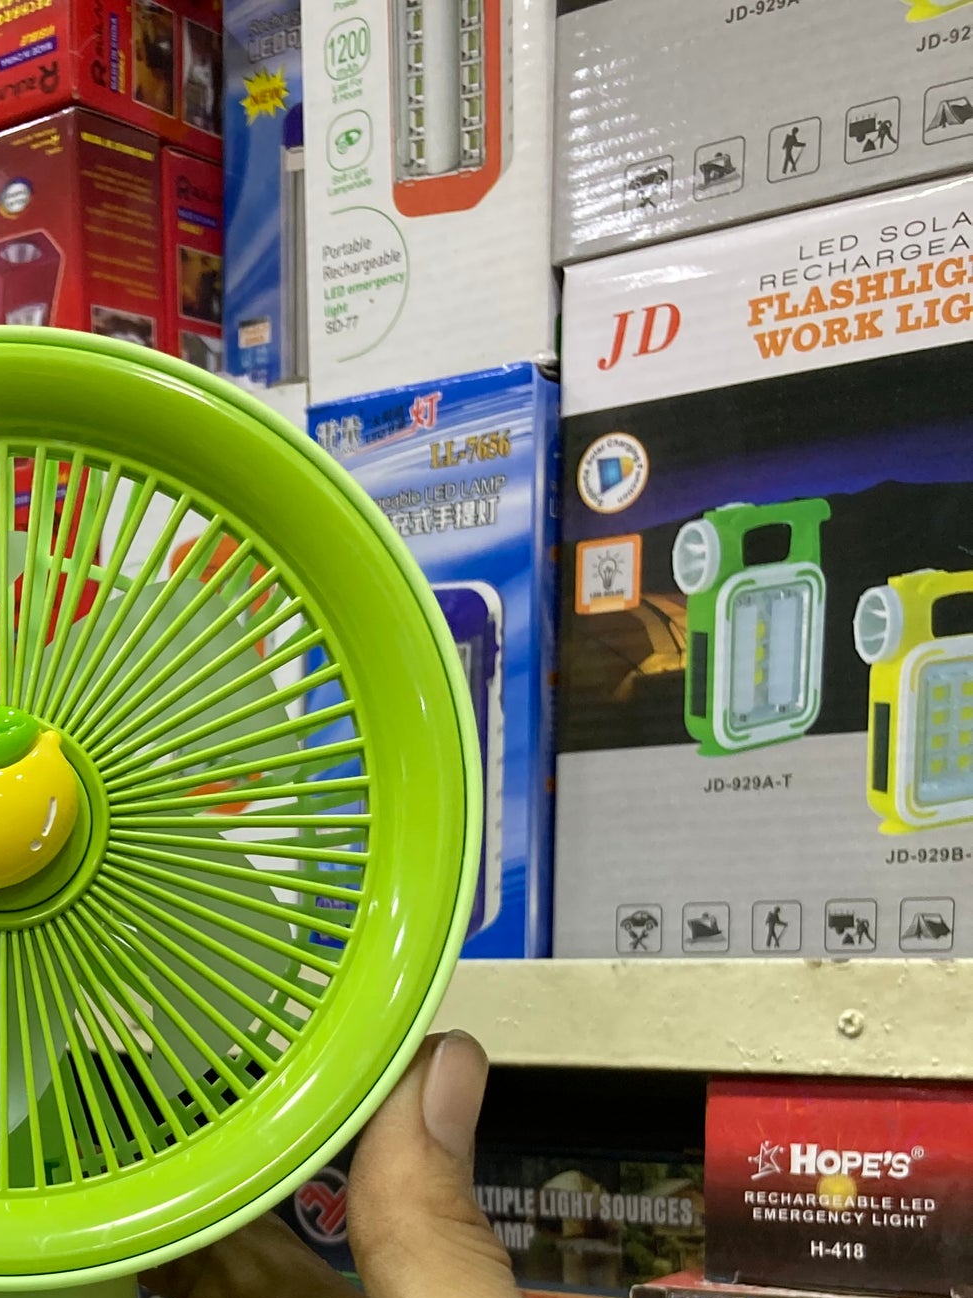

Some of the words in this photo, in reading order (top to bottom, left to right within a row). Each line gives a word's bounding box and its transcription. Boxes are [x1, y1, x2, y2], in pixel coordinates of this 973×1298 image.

[328, 26, 368, 68] 1200
[915, 24, 973, 53] JD-92
[322, 235, 373, 263] Portable
[798, 233, 860, 261] LED
[879, 211, 973, 243] SOLA
[322, 249, 403, 281] Rechargeable
[758, 235, 973, 292] RECHARGEA
[346, 271, 406, 295] emergency
[747, 254, 973, 327] FLASHLIG
[596, 302, 682, 373] JD
[753, 308, 885, 360] WORK
[894, 292, 973, 335] LIG
[429, 429, 512, 470] LL-7656
[423, 481, 457, 502] LED
[459, 474, 508, 496] LAMP
[388, 496, 500, 538] 充式手提灯
[703, 772, 793, 796] JD-929A-T
[884, 844, 973, 867] JD-929B-
[475, 1184, 535, 1217] LTIPLE
[538, 1189, 594, 1220] LIGHT
[744, 1190, 894, 1212] RECHARGEABLE
[900, 1197, 936, 1212] LED
[752, 1206, 865, 1226] EMERGENCY
[872, 1212, 928, 1229] LIGHT
[493, 1220, 535, 1250] AMP
[809, 1239, 865, 1261] H-418
